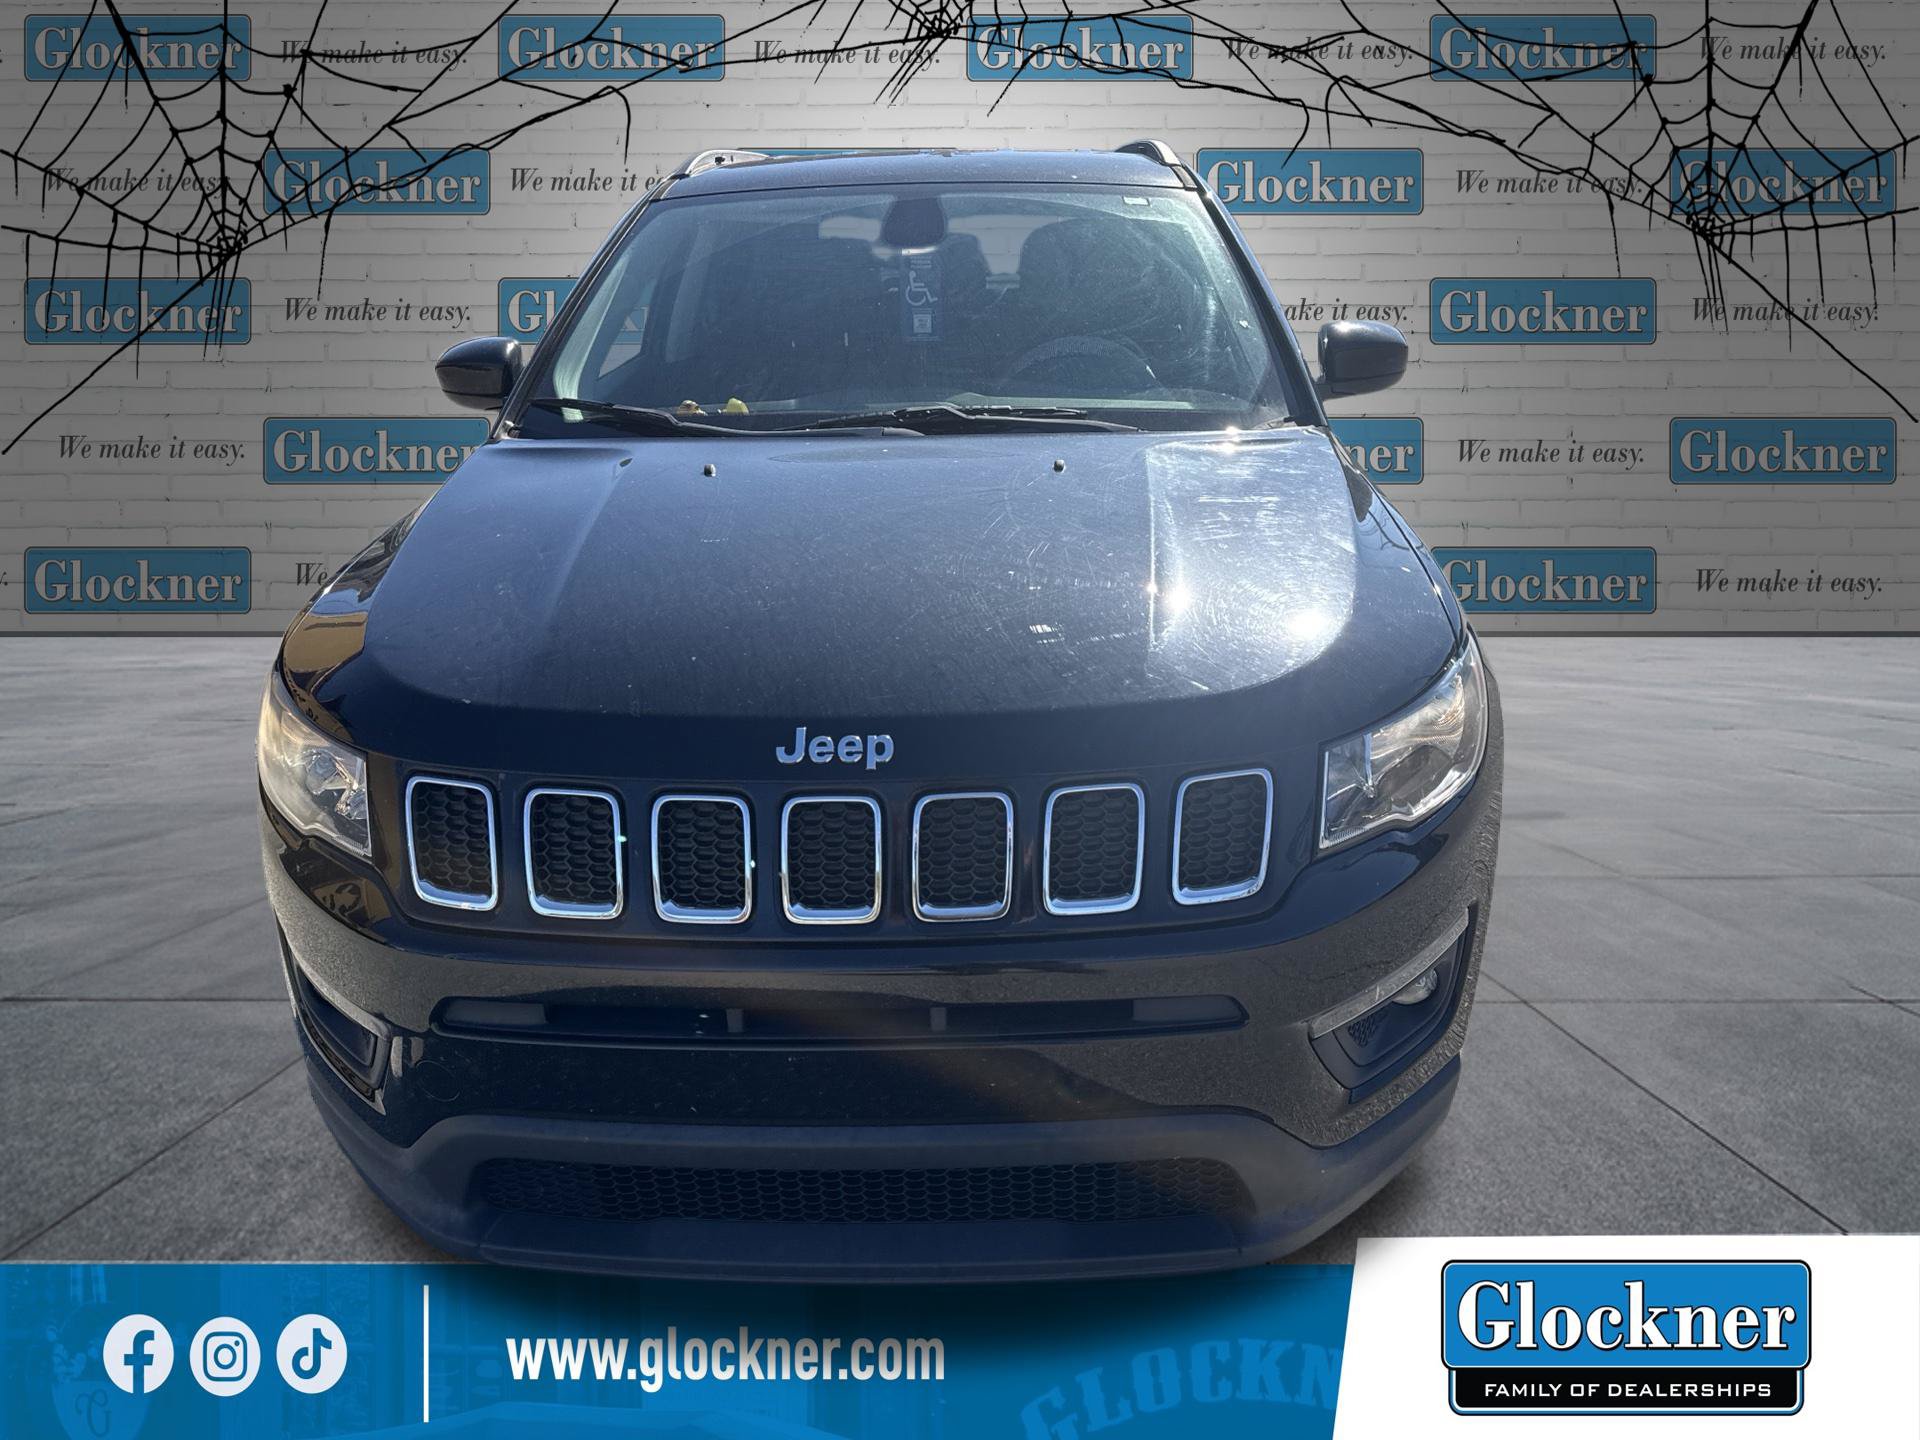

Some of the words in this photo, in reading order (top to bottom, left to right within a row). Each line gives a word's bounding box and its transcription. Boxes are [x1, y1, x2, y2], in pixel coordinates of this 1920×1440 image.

[34, 27, 242, 70] Glockner
[321, 41, 382, 64] make
[391, 41, 407, 64] it
[415, 48, 467, 70] easy.
[507, 27, 715, 70] Glockner
[754, 40, 786, 63] We
[794, 40, 855, 63] make
[864, 40, 880, 63] it
[888, 47, 940, 69] easy.
[976, 27, 1184, 70] Glockner
[1227, 38, 1258, 61] We
[1337, 38, 1353, 61] it
[1361, 45, 1413, 67] easy.
[1439, 27, 1647, 70] Glockner
[1700, 37, 1732, 60] We
[1810, 37, 1826, 60] it
[1834, 44, 1886, 66] easy.
[46, 169, 78, 192] We
[86, 169, 147, 192] make
[156, 169, 172, 192] it
[273, 160, 481, 204] Glockner
[511, 168, 542, 191] We
[551, 168, 612, 191] make
[621, 168, 637, 191] it
[1207, 160, 1415, 204] Glockner
[1456, 170, 1488, 193] We
[1496, 170, 1557, 193] make
[1566, 170, 1582, 193] it
[1590, 177, 1642, 199] easy.
[1680, 160, 1888, 204] Glockner
[34, 290, 242, 334] Glockner
[285, 298, 316, 321] We
[325, 298, 386, 321] make
[395, 298, 411, 321] it
[419, 305, 471, 327] easy.
[1285, 298, 1323, 321] ake
[1332, 298, 1348, 321] it
[1356, 305, 1407, 327] easy.
[1439, 290, 1647, 334] Glockner
[1692, 298, 1724, 321] We
[1732, 298, 1793, 321] make
[1802, 298, 1818, 321] it
[1826, 305, 1878, 327] easy.
[58, 436, 90, 459] We
[98, 436, 159, 459] make
[168, 436, 184, 459] it
[192, 443, 244, 465] easy.
[1458, 440, 1490, 464] We
[1498, 440, 1559, 464] make
[1568, 440, 1584, 464] it
[1592, 448, 1644, 470] easy.
[1679, 430, 1887, 474] Glockner
[34, 559, 242, 602] Glockner
[296, 563, 328, 586] We
[1443, 559, 1648, 602] Glockner
[1697, 569, 1728, 592] We
[1737, 569, 1798, 592] make
[1807, 569, 1823, 592] it
[1831, 576, 1883, 598] easy.
[776, 727, 895, 770] Jeep
